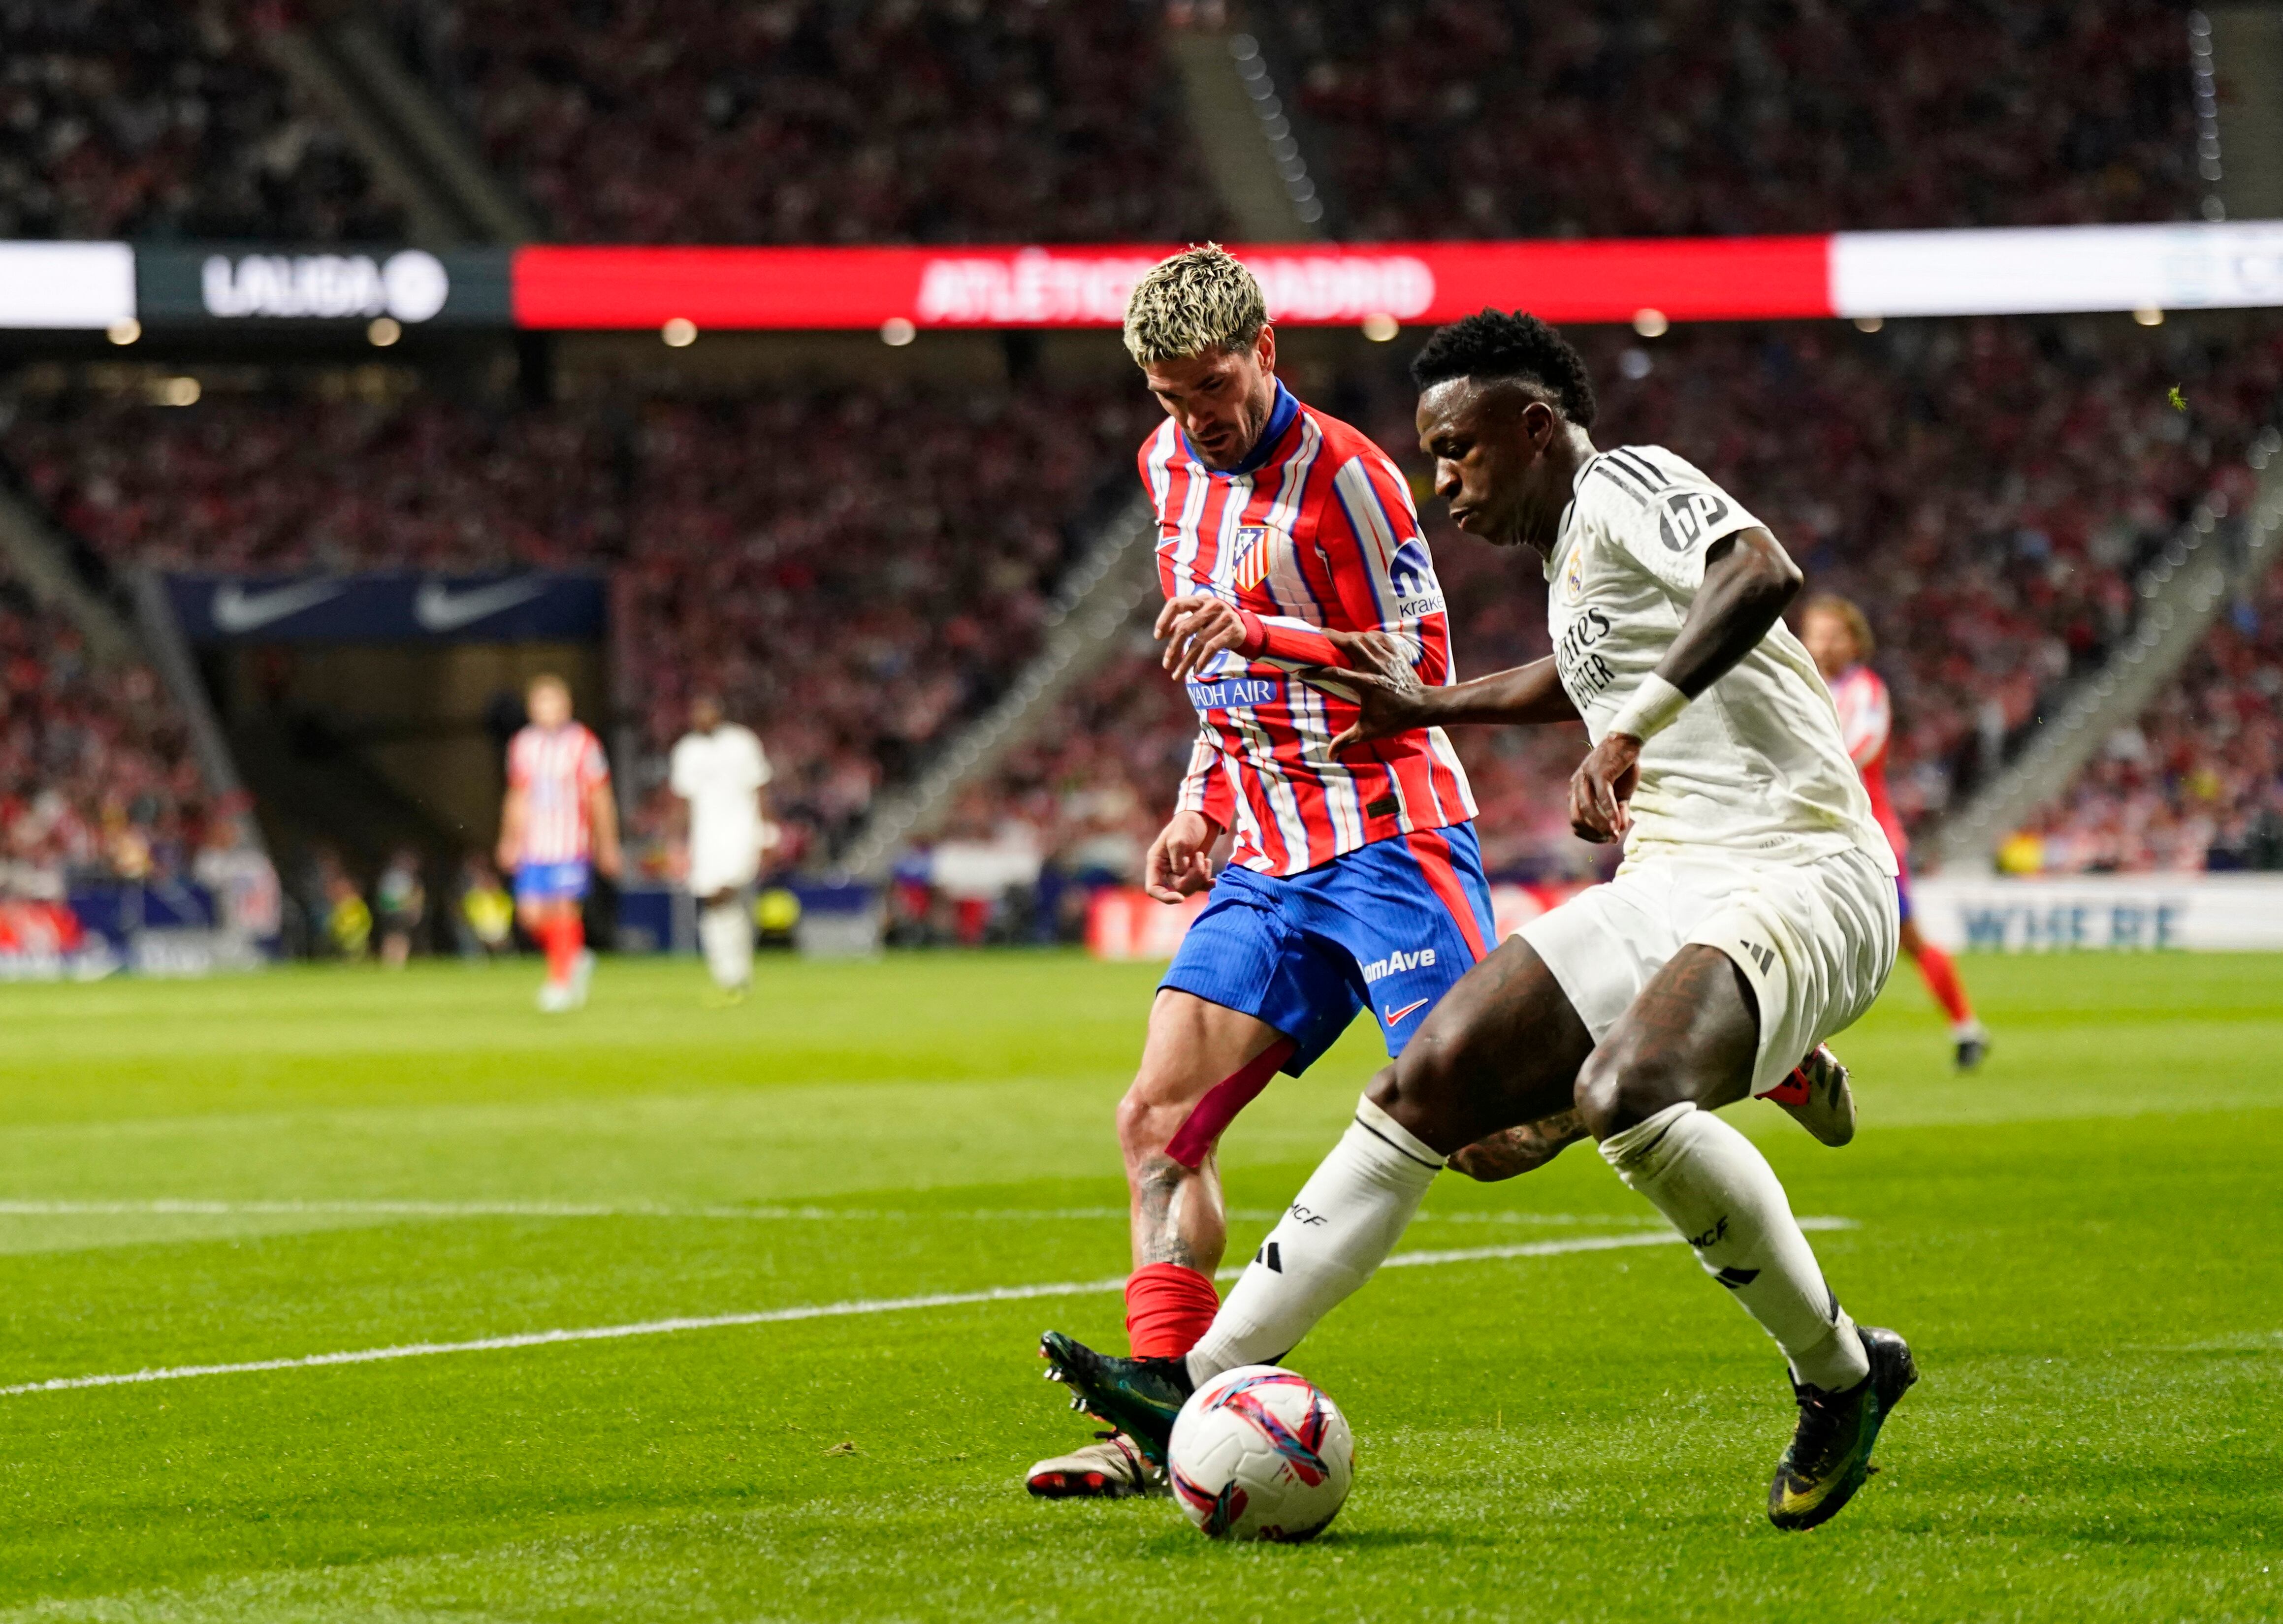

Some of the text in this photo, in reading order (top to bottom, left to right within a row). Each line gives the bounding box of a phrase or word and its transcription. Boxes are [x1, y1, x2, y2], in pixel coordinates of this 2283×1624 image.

[1661, 493, 1729, 552] hp
[1399, 595, 1444, 618] krake
[1232, 680, 1272, 704] AIR
[1356, 948, 1436, 985] omAve
